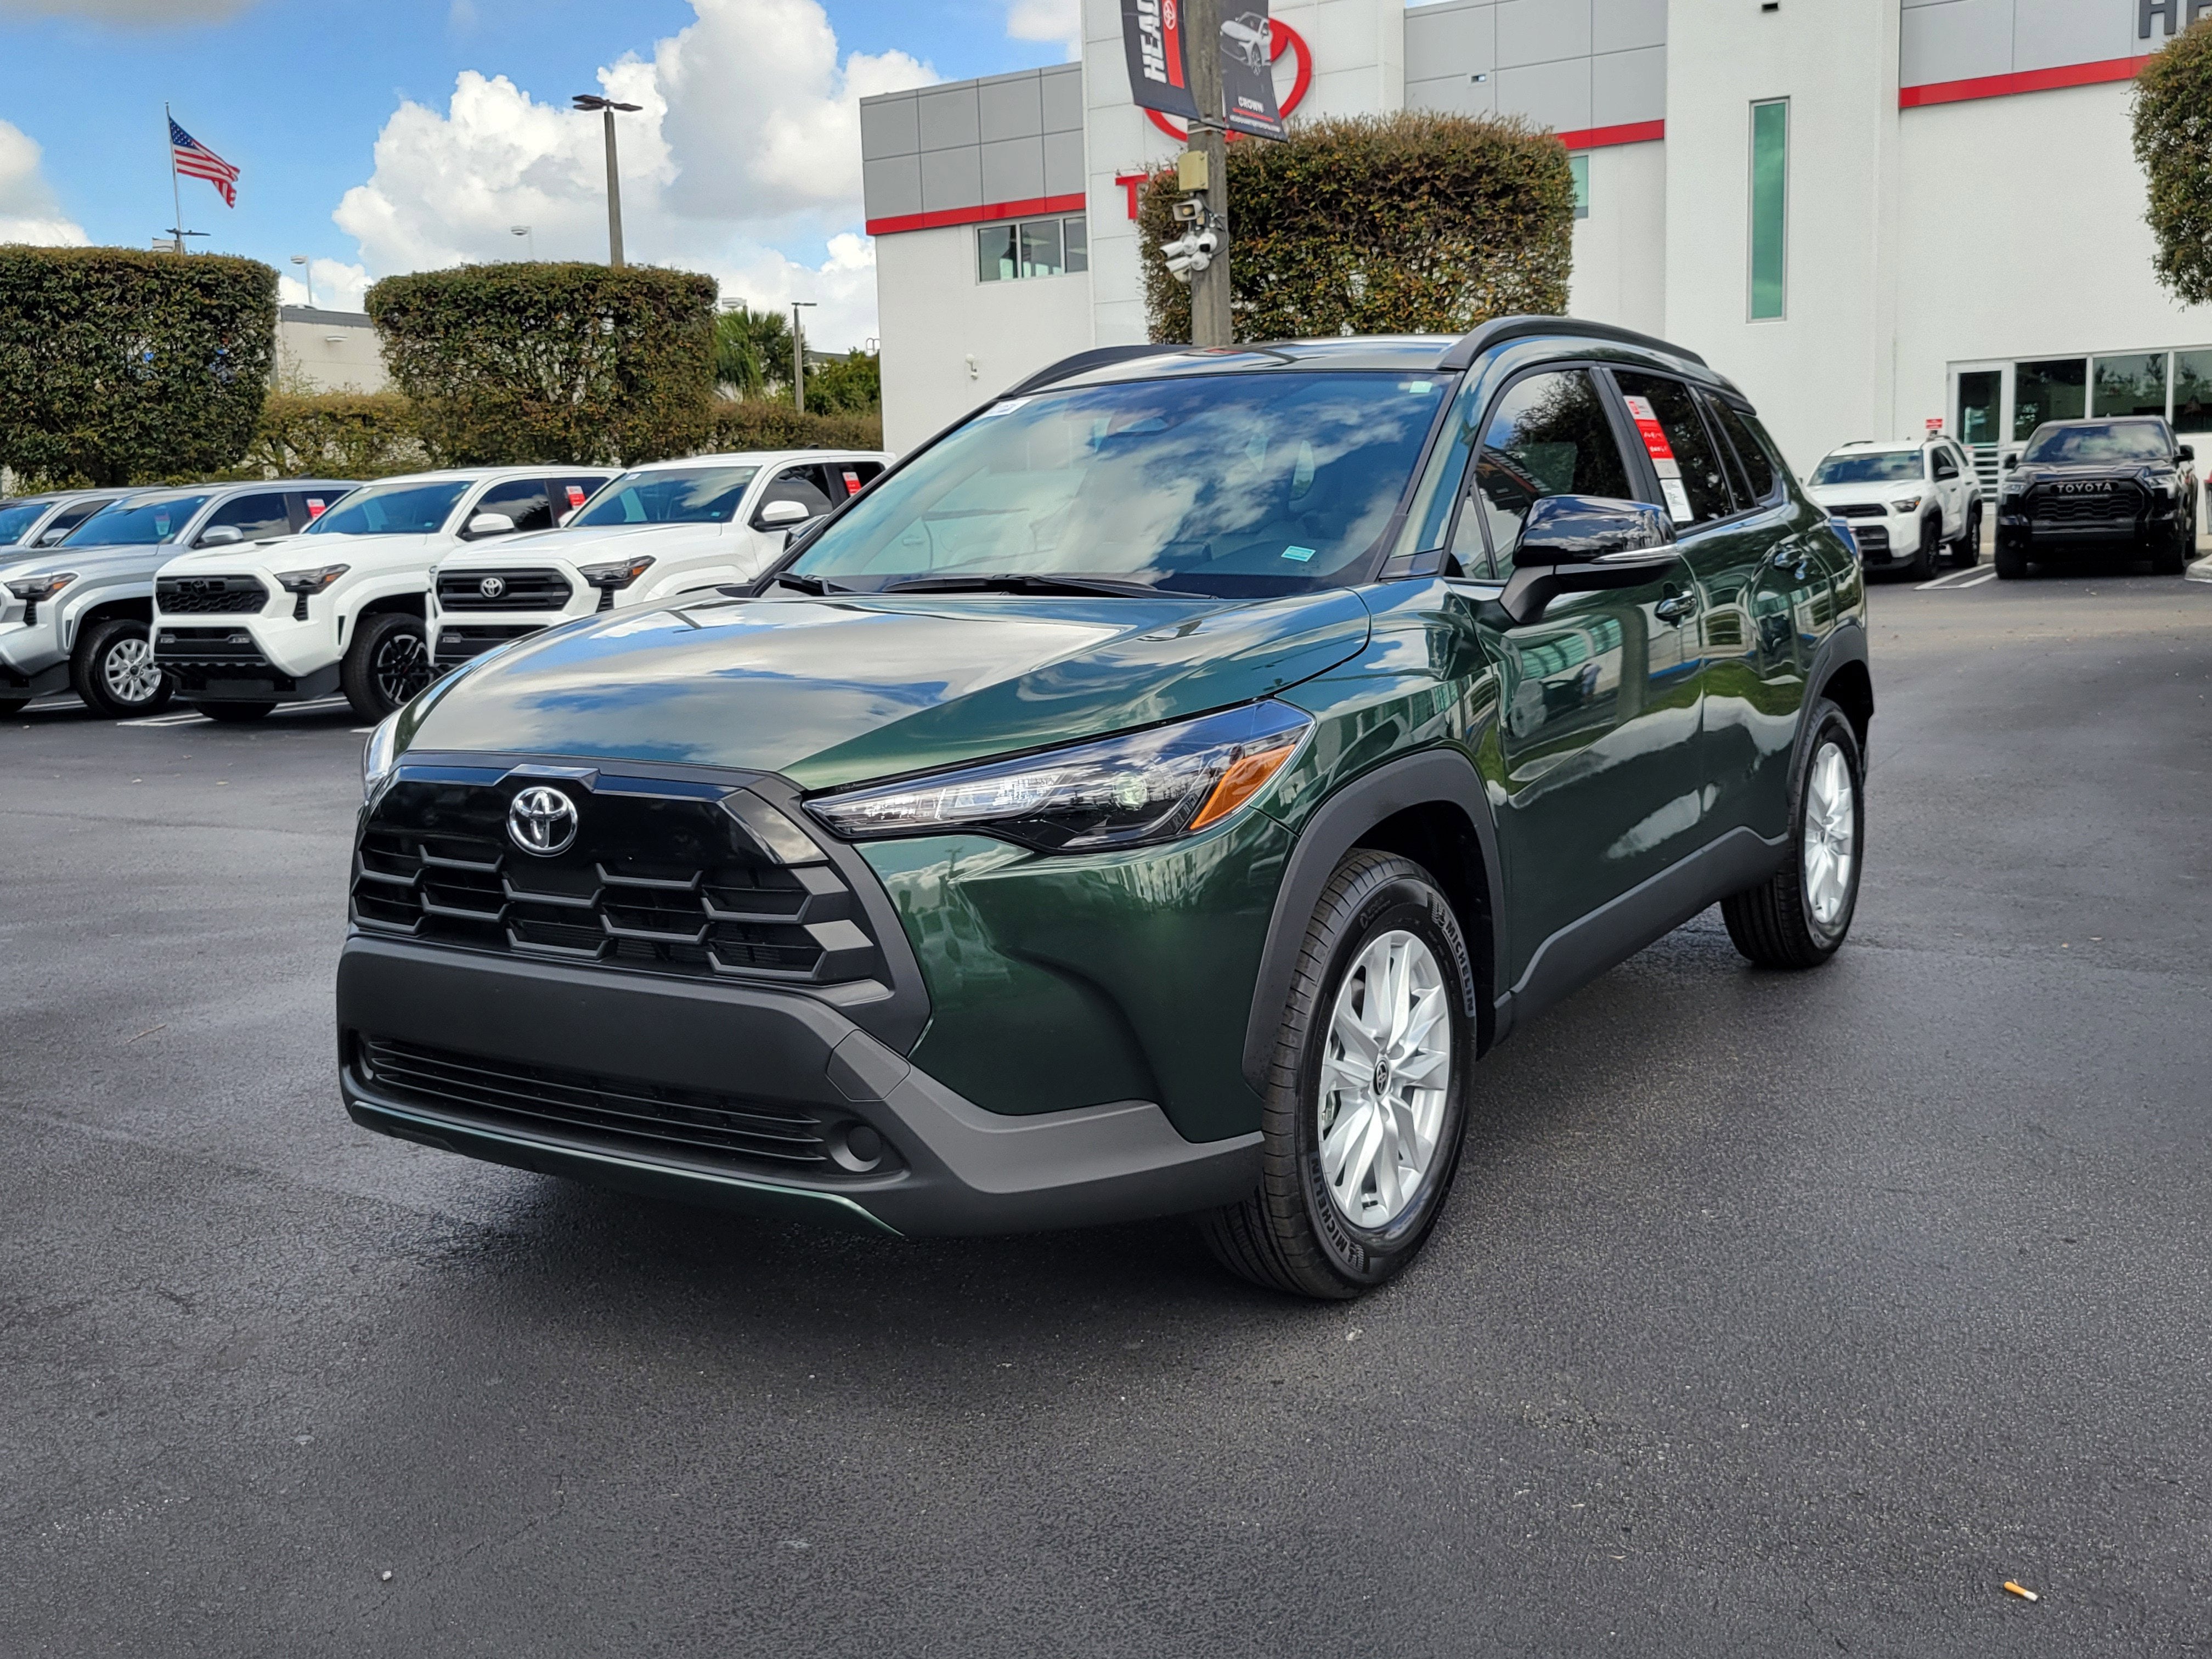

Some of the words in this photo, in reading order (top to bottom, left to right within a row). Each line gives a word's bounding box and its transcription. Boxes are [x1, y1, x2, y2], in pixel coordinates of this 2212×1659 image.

[2057, 483, 2112, 494] TOYOTA
[1446, 919, 1474, 1012] MICHELIN
[1311, 1158, 1348, 1253] MICHELIN
